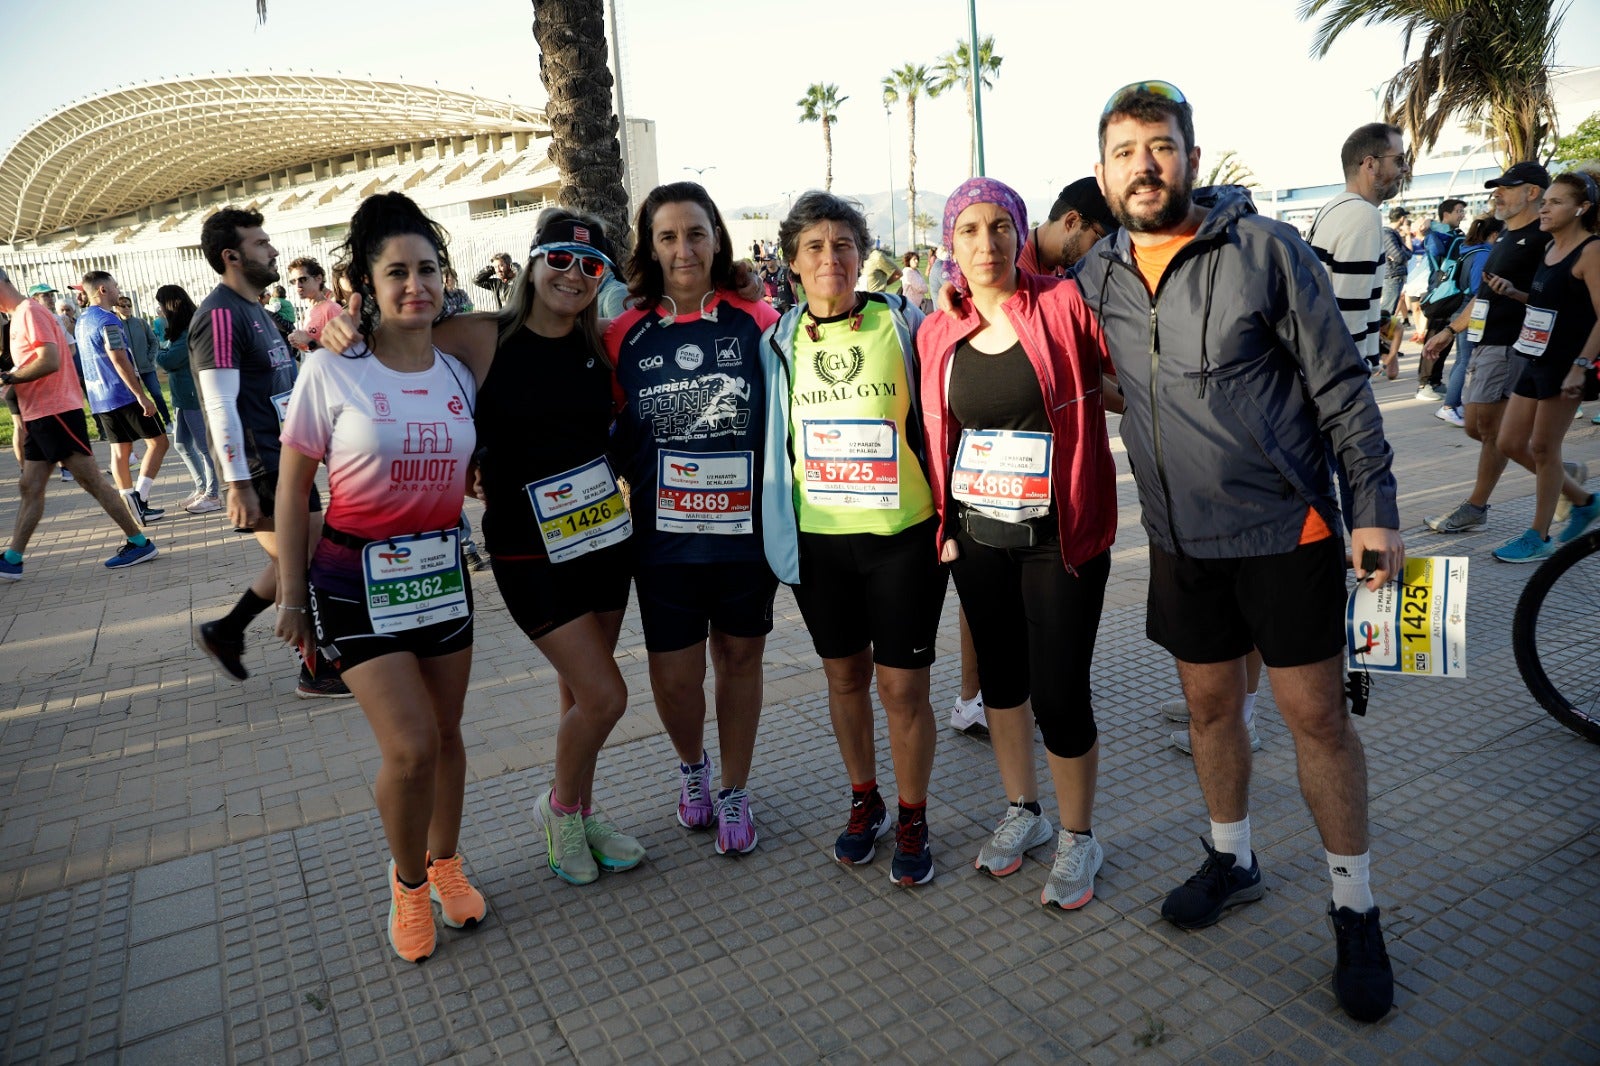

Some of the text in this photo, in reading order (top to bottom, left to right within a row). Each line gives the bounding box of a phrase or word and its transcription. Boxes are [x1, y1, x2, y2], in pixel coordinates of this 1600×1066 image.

[719, 349, 737, 359] AXA
[857, 382, 897, 398] GYM
[390, 459, 458, 483] QUIJOTE
[825, 461, 874, 481] 5725
[973, 470, 1024, 498] 4866
[680, 492, 730, 511] 4869
[566, 502, 612, 532] 1426
[583, 527, 603, 537] VEGA
[395, 575, 443, 602] 3362
[1384, 605, 1391, 613] DE
[1403, 586, 1429, 643] 1425
[1431, 595, 1442, 638] ANTOÑACO
